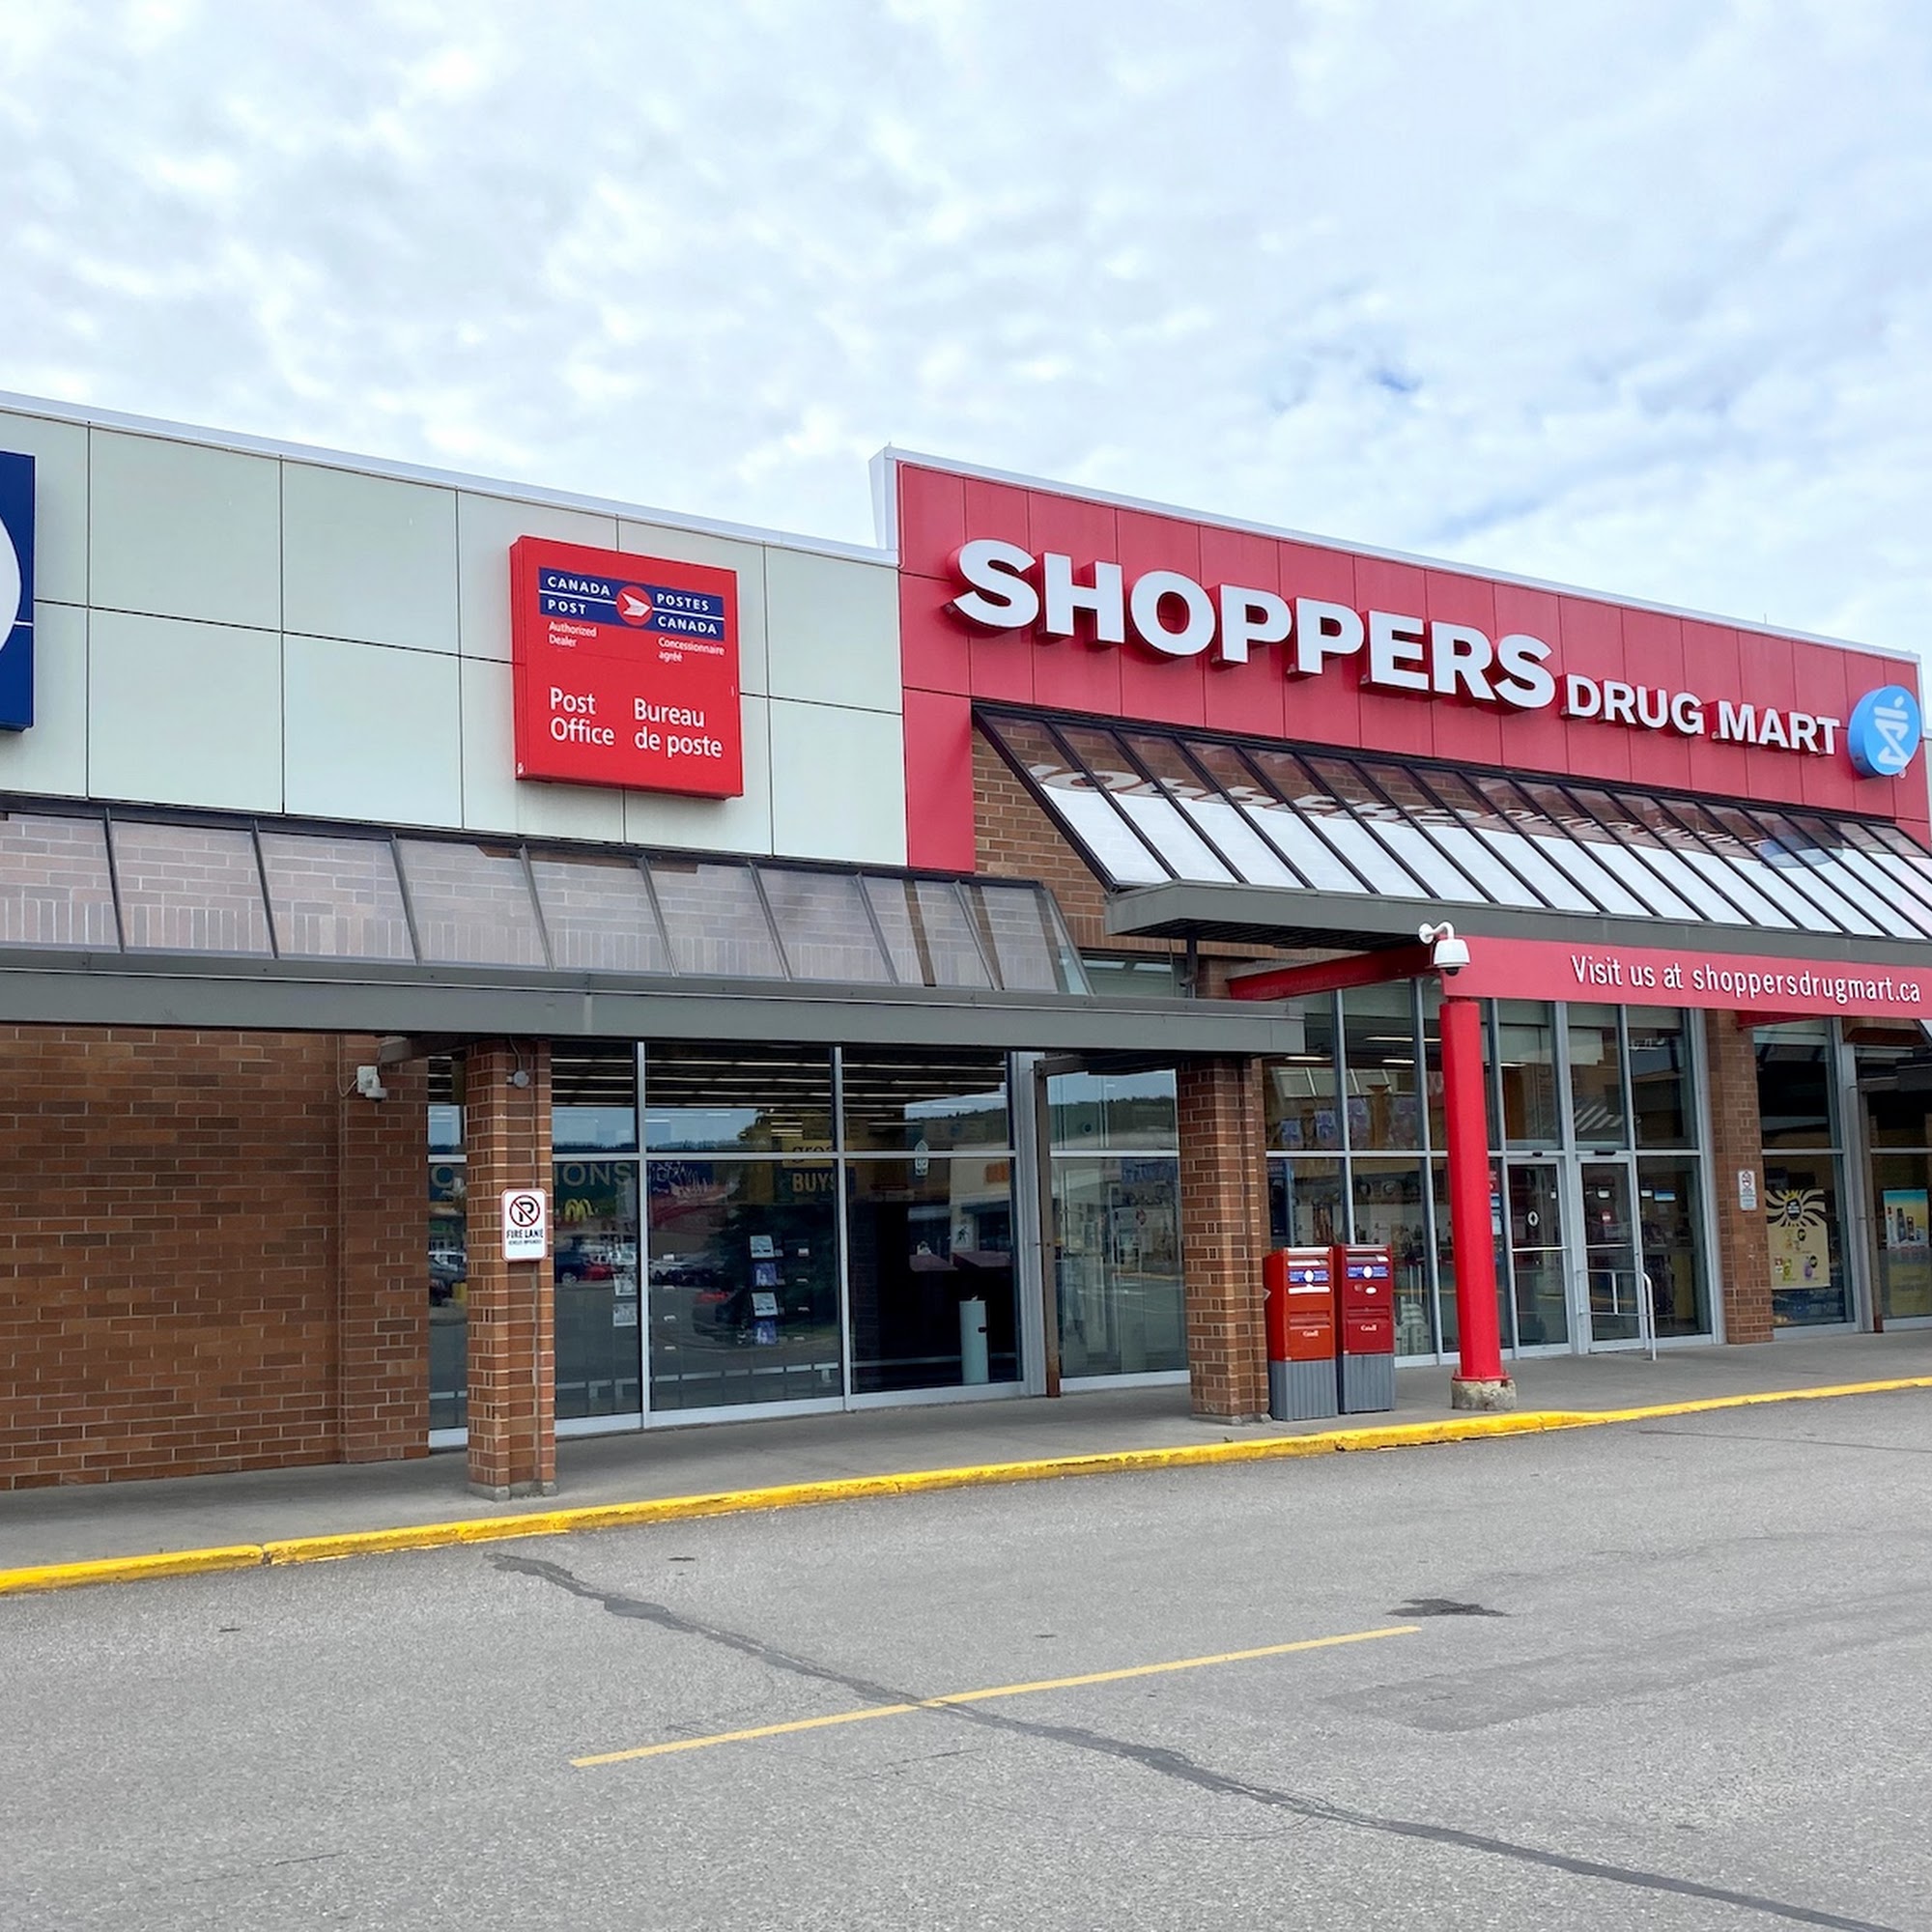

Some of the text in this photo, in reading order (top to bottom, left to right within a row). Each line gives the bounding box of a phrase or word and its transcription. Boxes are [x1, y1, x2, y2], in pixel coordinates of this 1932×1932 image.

[547, 576, 611, 596] CANADA
[547, 599, 586, 615] POST
[657, 593, 710, 611] POSTES
[548, 621, 597, 638] Authorized
[658, 615, 718, 635] CANADA
[952, 538, 1556, 709] SHOPPERS
[548, 634, 577, 647] Dealer
[658, 636, 725, 656] Concessionnaire
[549, 687, 596, 715] Post
[634, 697, 705, 727] Bureau
[1566, 673, 1840, 756] DRUG MART
[551, 716, 615, 746] Office
[634, 726, 723, 757] de poste
[1571, 954, 1922, 1005] Visit us at shoppersdrugmart.ca
[506, 1228, 544, 1238] FIRE LANE
